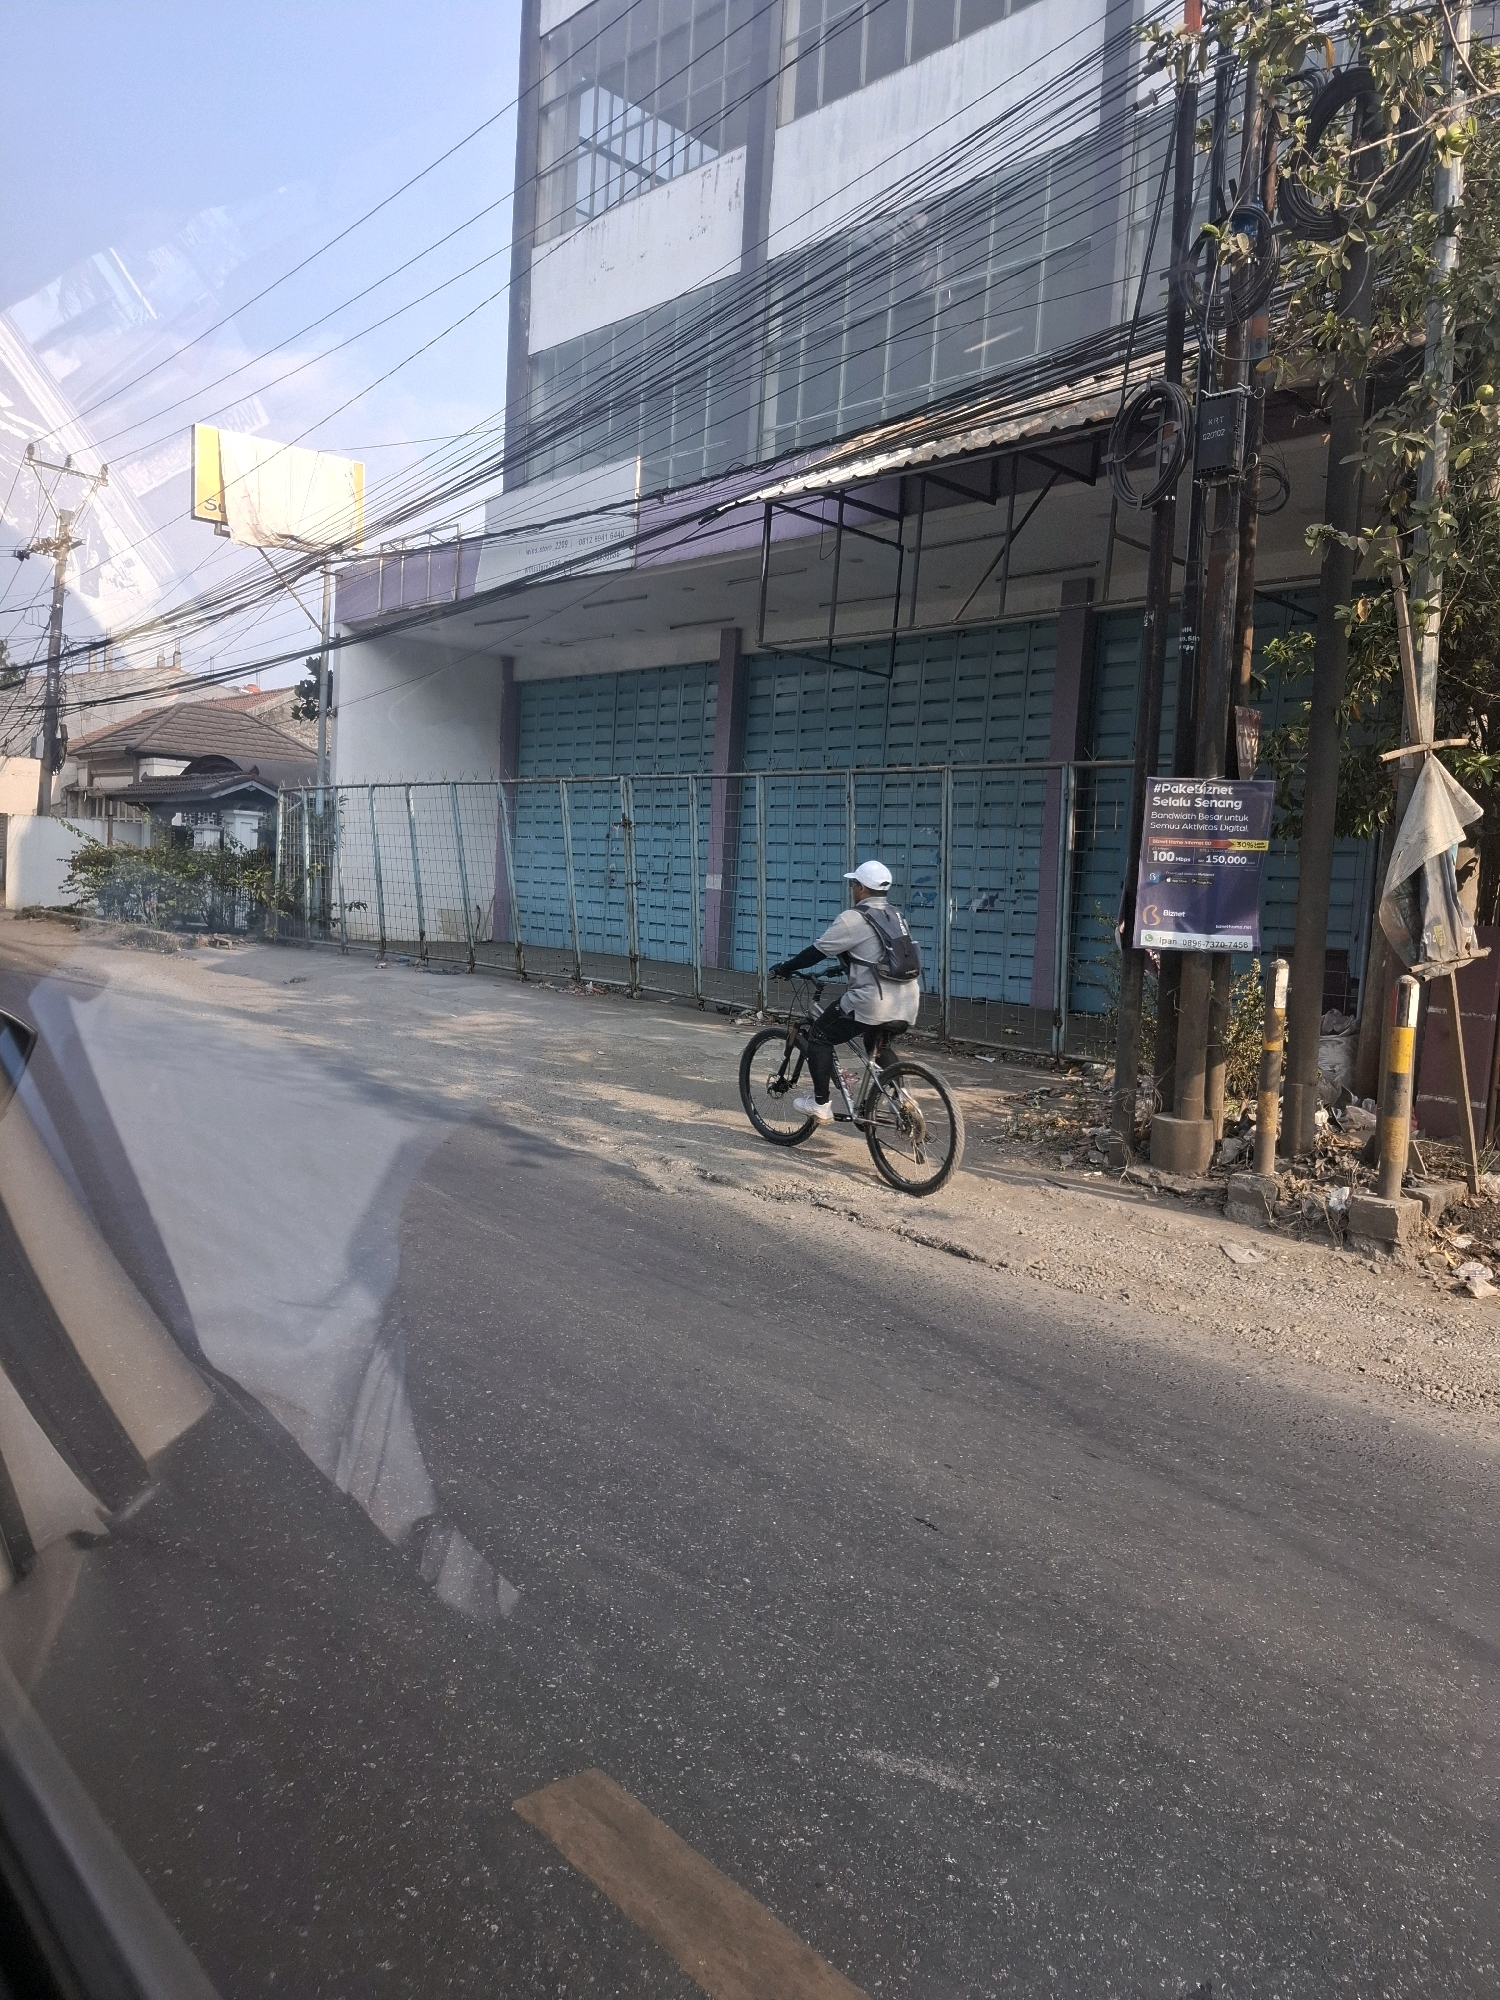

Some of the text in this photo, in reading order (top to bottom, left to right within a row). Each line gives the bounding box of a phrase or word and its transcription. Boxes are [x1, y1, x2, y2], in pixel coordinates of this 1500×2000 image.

[1153, 783, 1234, 795] #PakeBiznet
[1152, 796, 1243, 810] Selalu Senang
[1151, 811, 1249, 822] Bandwidth Besar untuk
[1150, 822, 1180, 830] Semua
[1181, 823, 1218, 831] Aktivitas
[1236, 841, 1253, 849] 30%
[1152, 850, 1175, 862] 100
[1205, 854, 1247, 865] 150,000
[1162, 909, 1186, 918] Biznet
